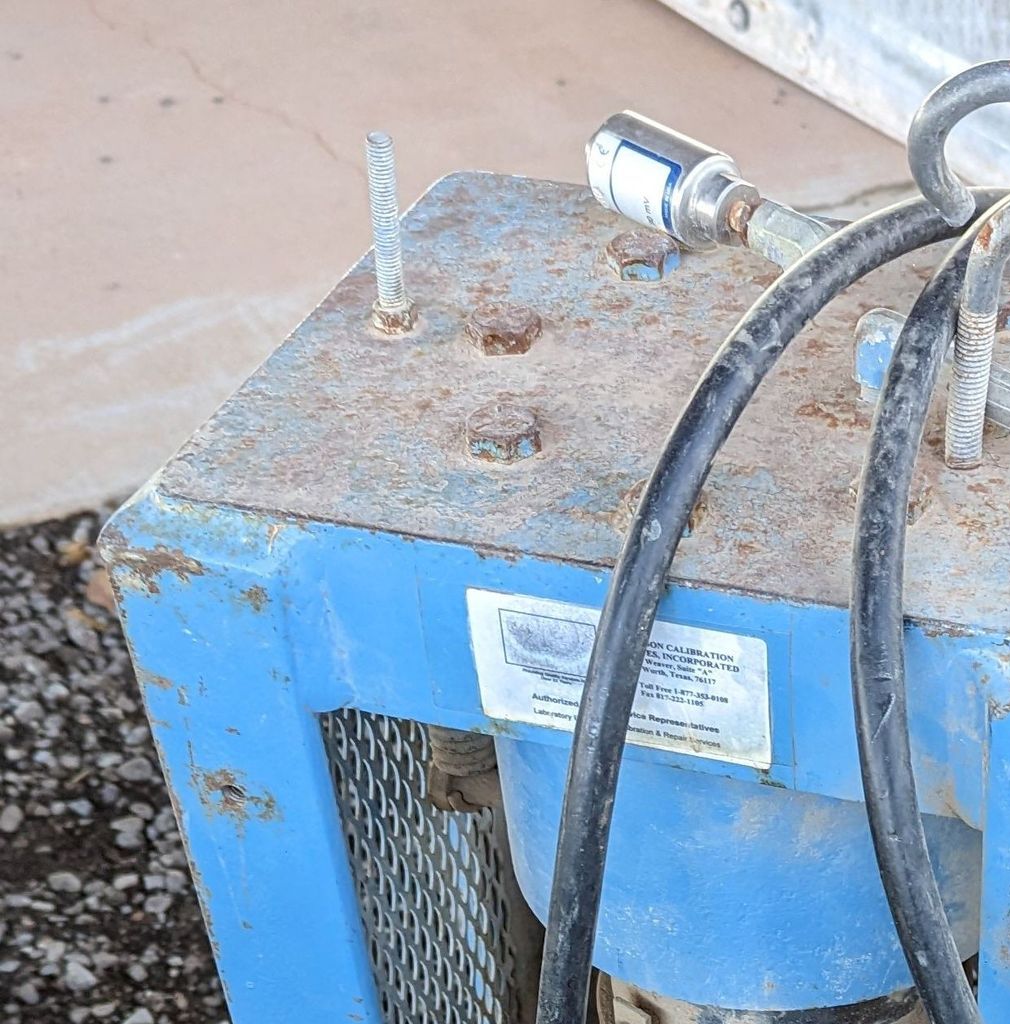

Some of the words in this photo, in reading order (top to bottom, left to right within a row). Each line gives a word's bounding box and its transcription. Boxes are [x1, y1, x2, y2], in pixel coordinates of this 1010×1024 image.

[649, 641, 664, 650] ON
[666, 644, 734, 662] CALIBRATION
[645, 658, 675, 670] Weaver,
[646, 650, 660, 660] ES,
[662, 653, 740, 673] INCORPORATED
[669, 671, 694, 682] Texas,
[695, 676, 716, 685] 76117
[640, 682, 653, 690] Toll
[656, 685, 672, 693] Free
[640, 690, 655, 698] Fax
[532, 692, 579, 707] Authorized
[648, 714, 720, 734] Representatives
[656, 729, 662, 737] &
[663, 731, 687, 741] Repair
